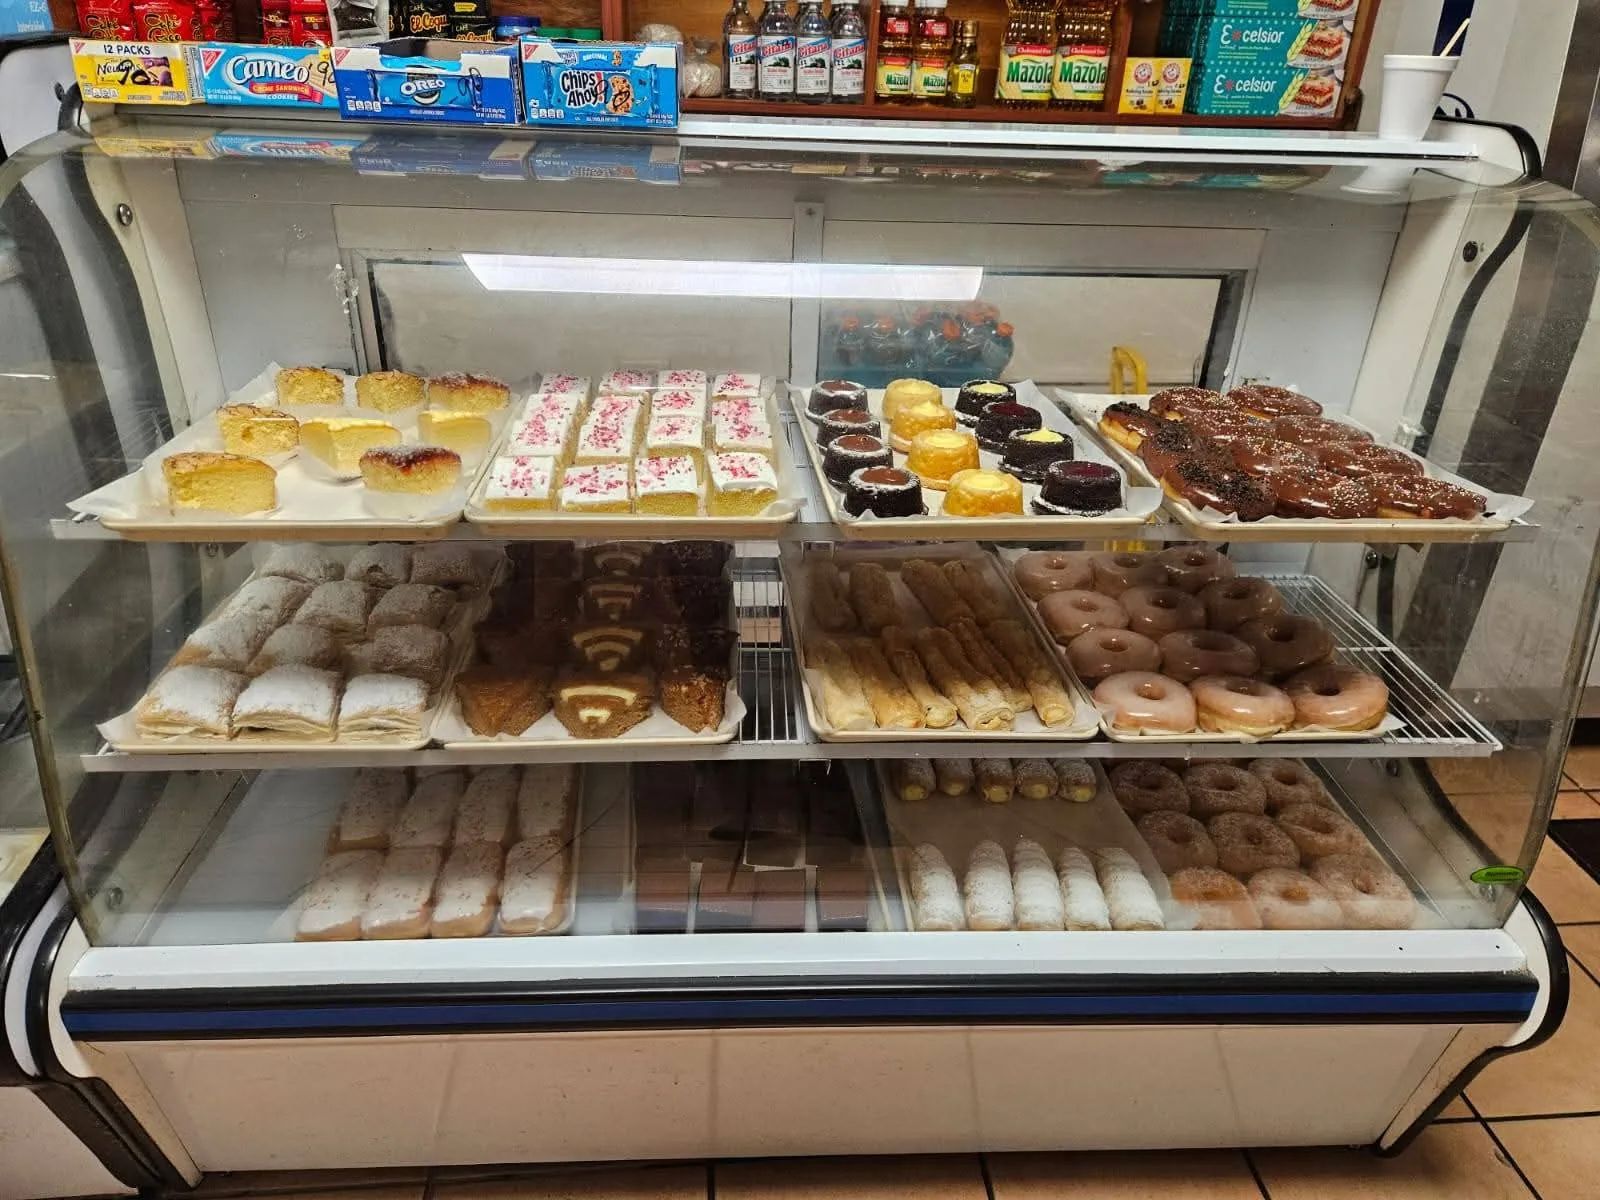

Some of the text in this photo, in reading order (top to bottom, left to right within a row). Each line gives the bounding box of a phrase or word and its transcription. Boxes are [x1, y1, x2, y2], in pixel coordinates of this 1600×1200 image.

[104, 45, 151, 55] 12 PACKS
[225, 55, 310, 86] Cameo
[1006, 61, 1053, 83] Mazola
[1060, 61, 1107, 83] Mazola
[561, 70, 597, 93] Chips
[886, 74, 909, 85] Mazola
[923, 76, 946, 87] Mazola
[275, 85, 310, 95] SANDWICH
[400, 80, 446, 97] OREO
